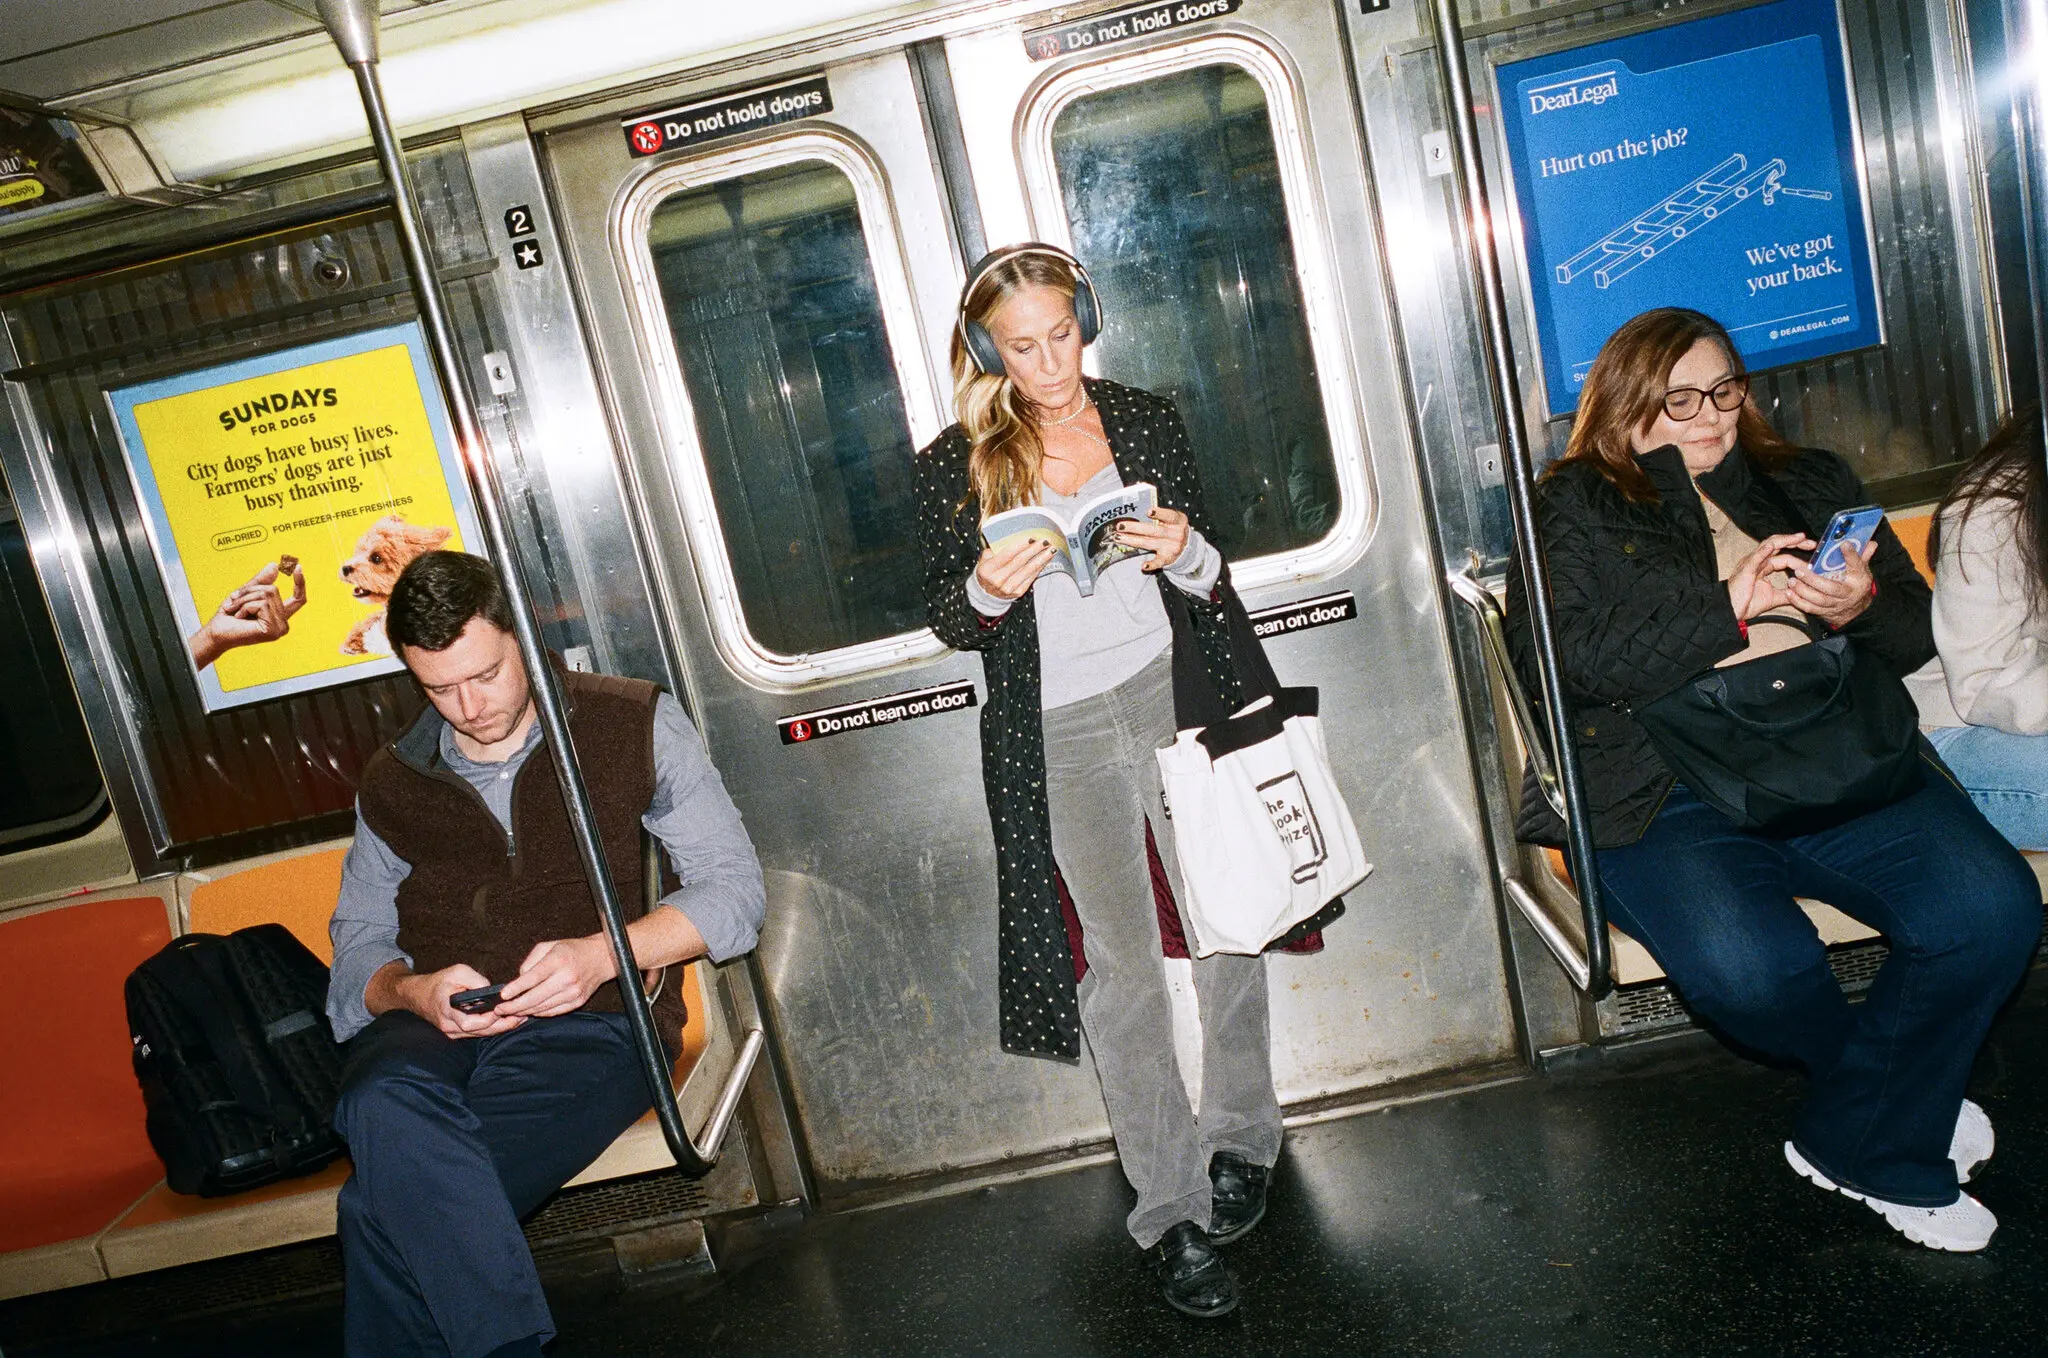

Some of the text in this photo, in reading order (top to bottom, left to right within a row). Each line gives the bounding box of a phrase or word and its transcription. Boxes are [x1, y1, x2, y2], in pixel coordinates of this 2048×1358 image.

[1068, 0, 1229, 49] Do not hold doors
[665, 90, 823, 140] Do not hold doors
[1529, 77, 1619, 114] DearLegal
[1540, 127, 1689, 177] Hurt on the job?
[10, 185, 36, 198] apply
[511, 211, 530, 233] 2
[1745, 233, 1835, 266] We've got
[1746, 256, 1843, 297] your back.
[1780, 315, 1850, 337] DEARLEGAL.COM
[218, 387, 338, 431] SUNDAYS
[250, 412, 316, 436] FOR DOGS
[187, 423, 399, 481] City dogs have busy lives.
[204, 443, 392, 499] Farmers' dogs are just
[244, 475, 363, 511] busy thawing.
[217, 495, 414, 547] AIR-DRIED FOR FREEZER-FREE FRESHNESS
[1253, 604, 1348, 636] ean on door
[816, 692, 969, 734] Do not lean on door
[1265, 799, 1285, 814] he
